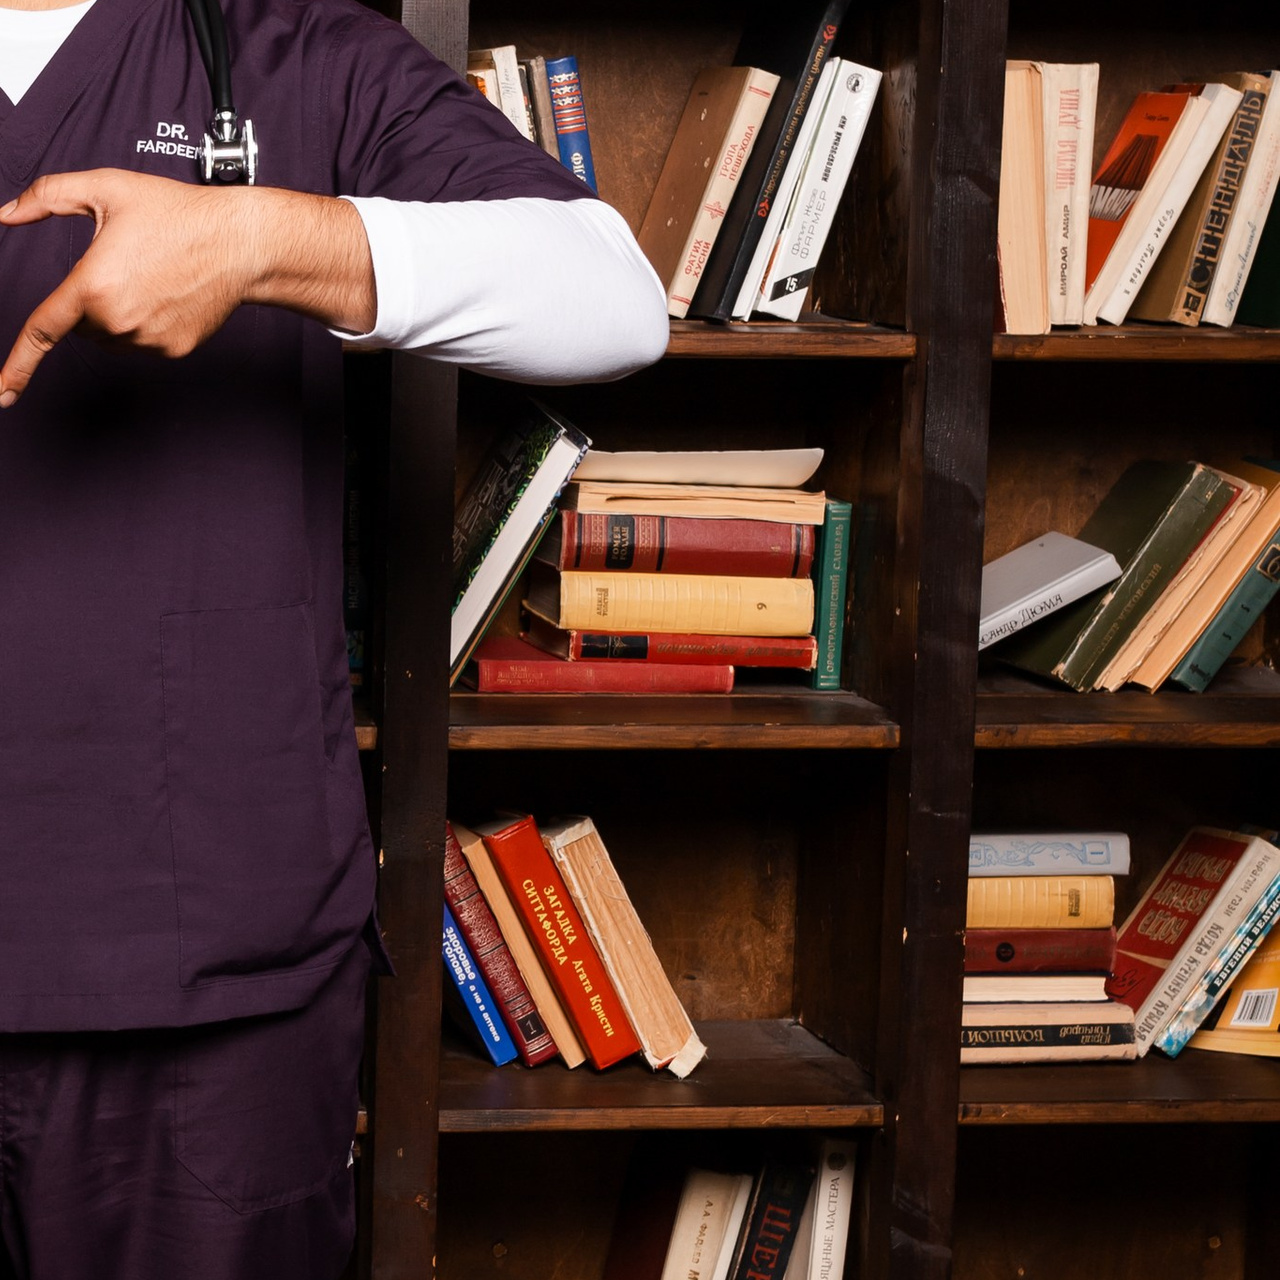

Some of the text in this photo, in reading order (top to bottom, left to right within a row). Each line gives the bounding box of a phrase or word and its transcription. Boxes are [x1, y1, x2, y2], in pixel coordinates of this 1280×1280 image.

[156, 122, 189, 141] DR.
[761, 44, 829, 199] Народные песни русских цыган
[819, 114, 849, 183] МНОГОЯРУСНЫЙ МИР
[1053, 86, 1085, 191] ЧИСТАЯ ДУША
[717, 141, 739, 179] ТРОПА
[726, 122, 756, 182] ПЕШЕХОДА
[1183, 86, 1268, 293] СТЕНДАЛЬ
[796, 189, 830, 260] ФАРМЕР
[1060, 204, 1072, 240] АМИР
[684, 239, 704, 276] ФАТИХ
[692, 241, 711, 278] ХУСНИ
[784, 277, 798, 293] 15
[823, 522, 845, 672] ОРФОГРАФИЧЕСКИЙ СЛОВАРЬ
[519, 876, 570, 966] СИТТАФОРДА
[541, 882, 580, 946] ЗАГАДКА
[437, 940, 469, 987] голове,
[443, 924, 479, 981] здоровье
[1211, 934, 1255, 989] ЕВГЕНИЙ
[570, 955, 616, 1038] Агата Кристи
[479, 1010, 502, 1043] аптеке
[967, 1023, 1110, 1046] Гончаров БОЛЬШОЙ
[1080, 1033, 1111, 1045] Юрий
[825, 1174, 841, 1231] МАСТЕРА
